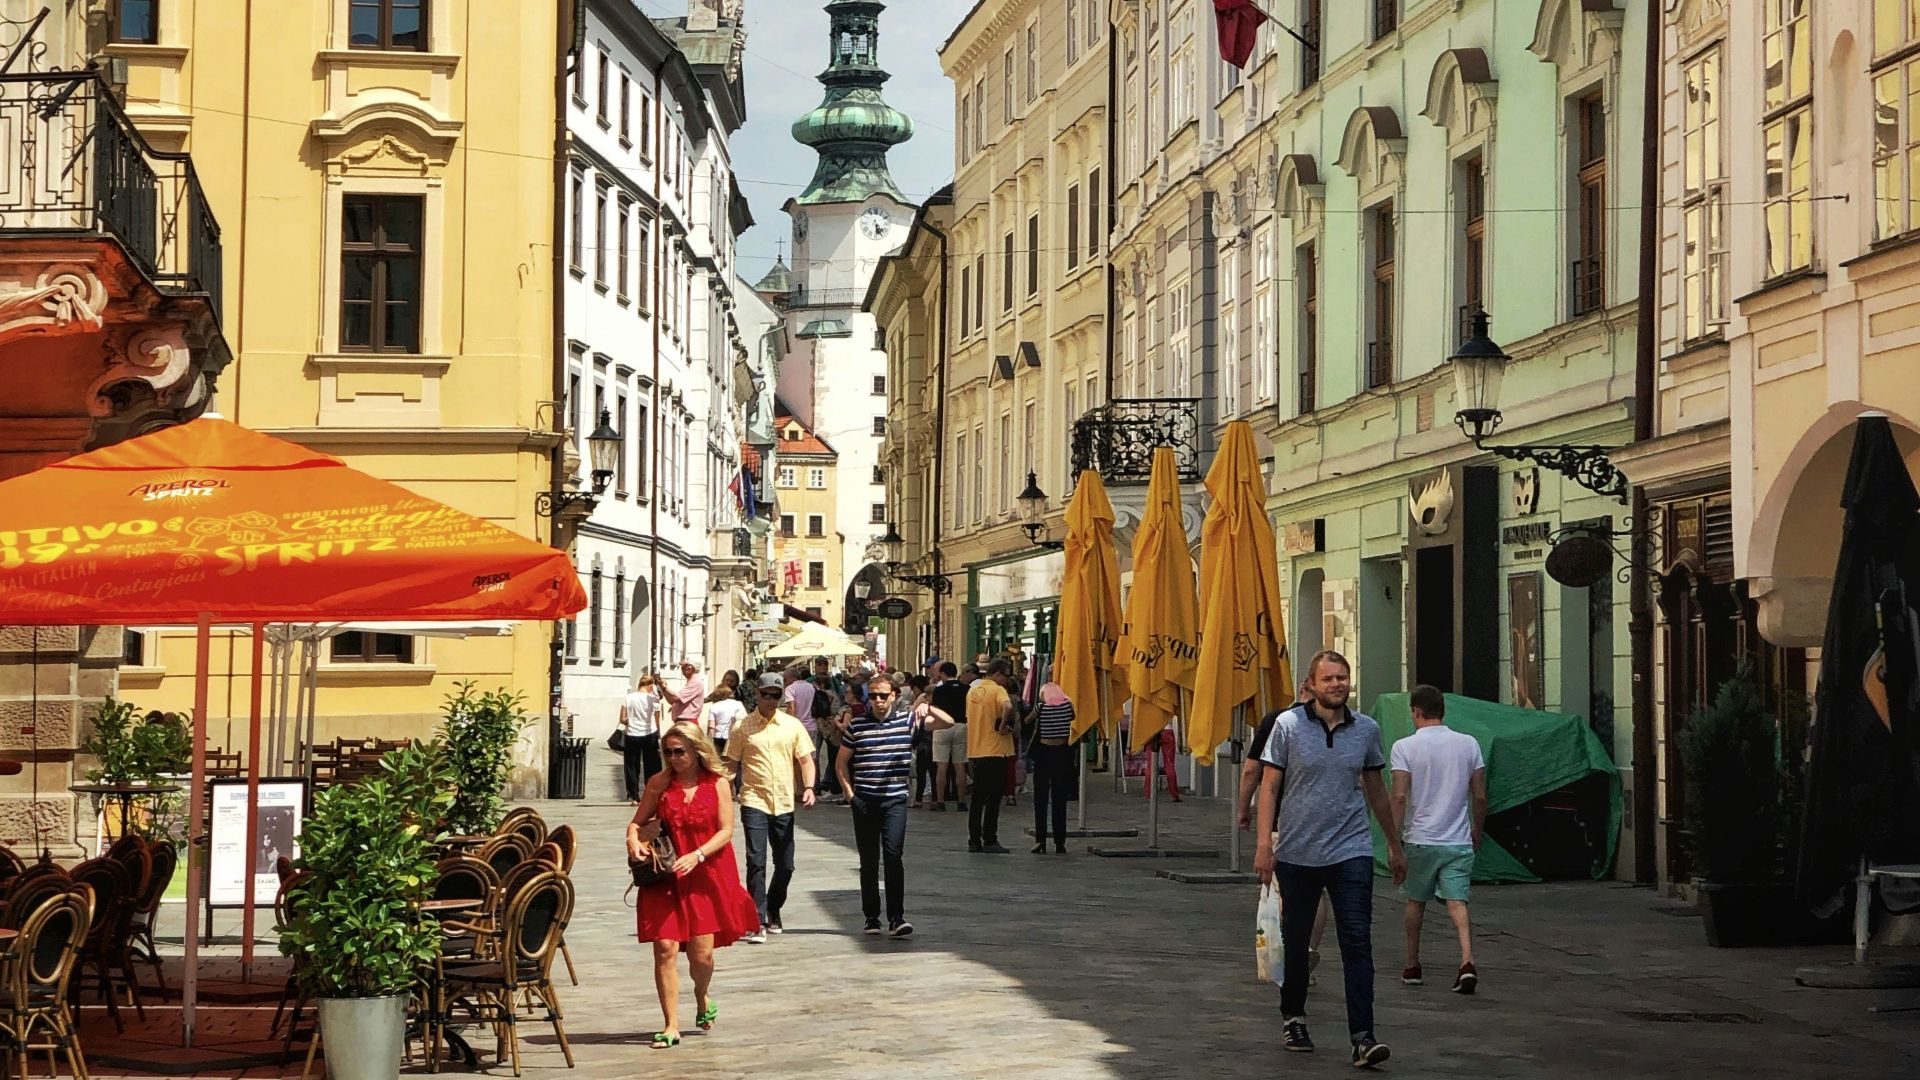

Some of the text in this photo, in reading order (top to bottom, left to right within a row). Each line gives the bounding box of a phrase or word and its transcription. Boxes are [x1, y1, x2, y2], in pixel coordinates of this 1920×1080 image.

[128, 479, 232, 496] APEROL
[142, 487, 214, 501] SPRITZ
[282, 504, 389, 520] SPONTANEOUS
[404, 539, 467, 549] PADOVA
[215, 537, 399, 577] SPRITZ
[33, 559, 97, 588] ITALIAN
[472, 571, 511, 588] APEROL
[95, 568, 206, 601] Contagious
